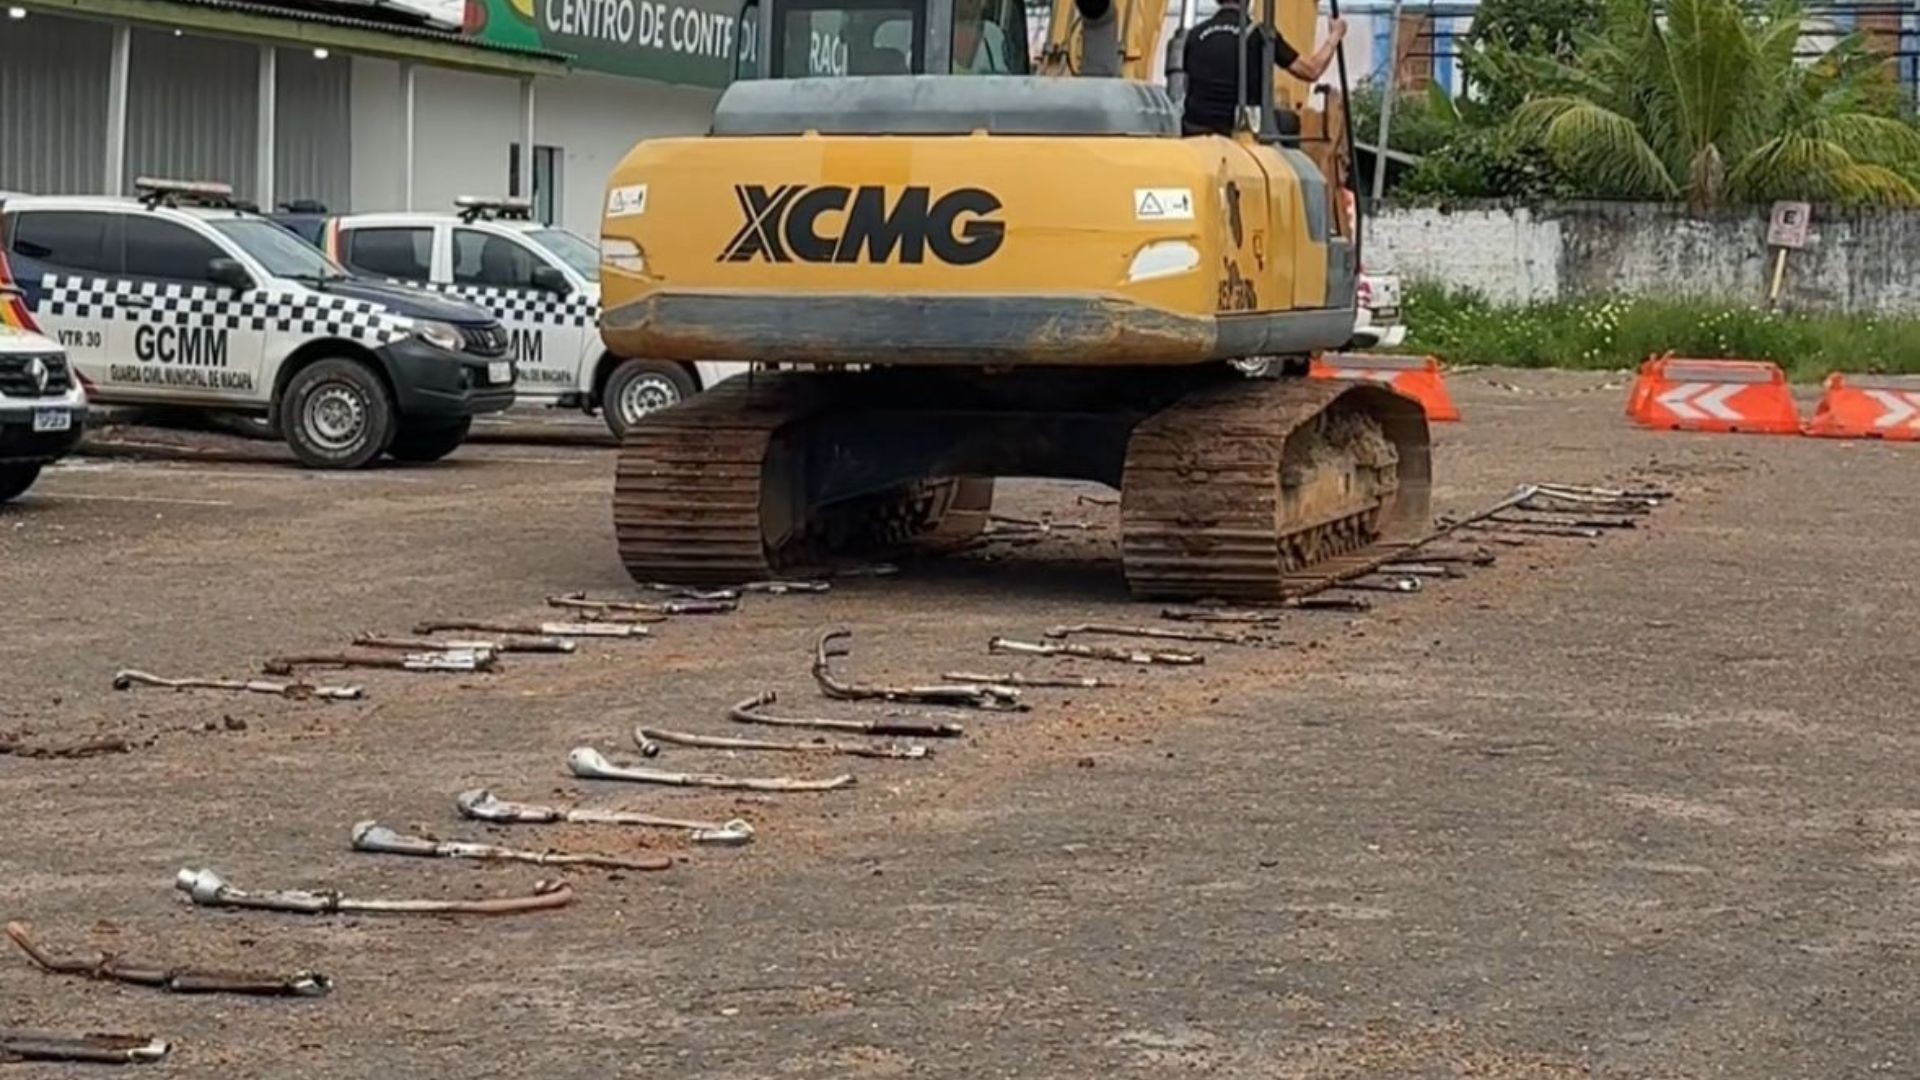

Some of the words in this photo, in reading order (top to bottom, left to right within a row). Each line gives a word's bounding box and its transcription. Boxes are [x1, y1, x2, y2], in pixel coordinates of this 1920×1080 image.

[545, 0, 635, 43] CENTRO
[639, 1, 667, 49] DE
[715, 184, 1006, 266] XCMG
[1783, 210, 1797, 225] E
[58, 329, 84, 346] VTR
[86, 330, 102, 348] 30
[135, 323, 229, 367] GCMM
[110, 363, 141, 382] GUARDA
[208, 370, 220, 388] DE
